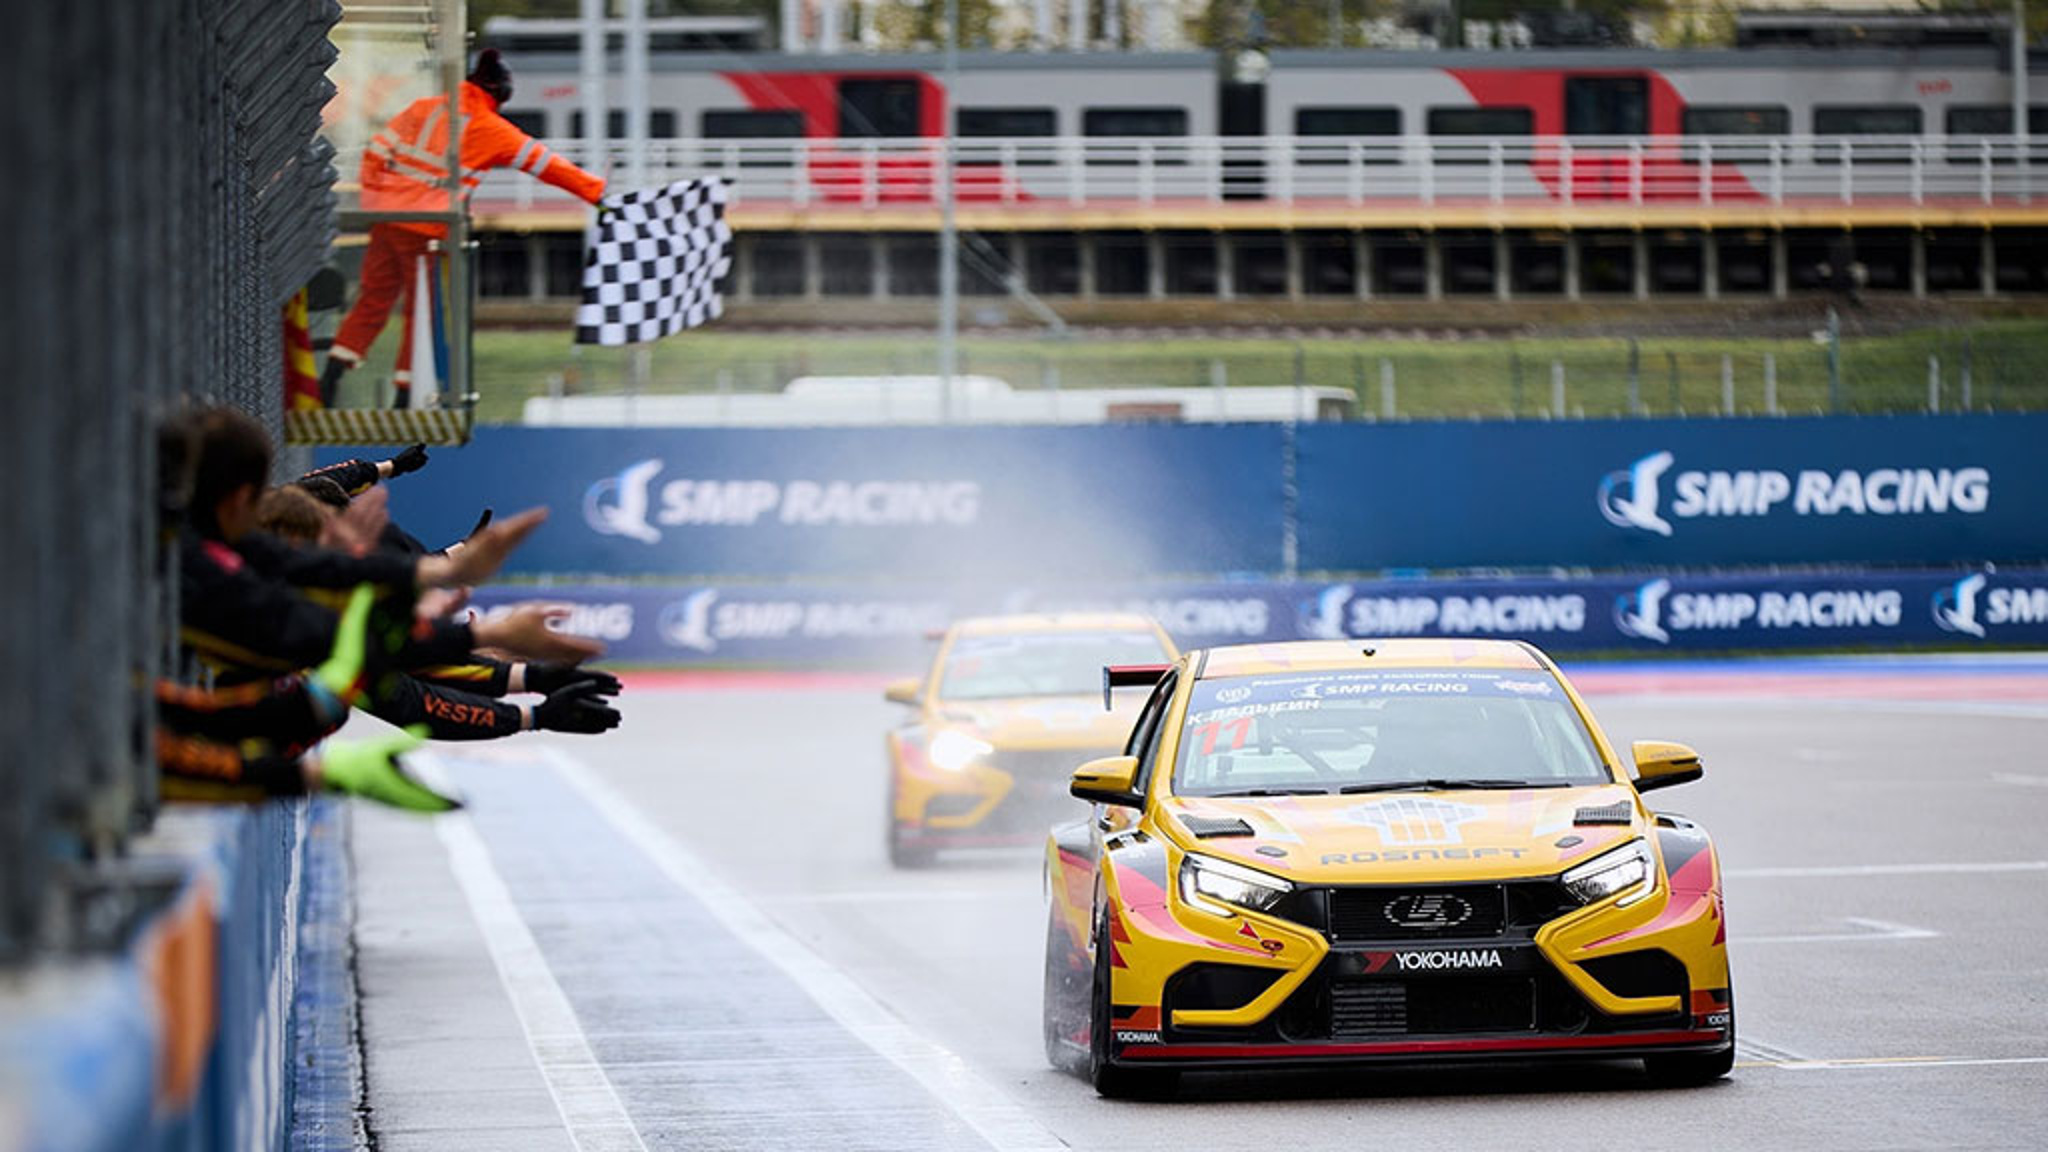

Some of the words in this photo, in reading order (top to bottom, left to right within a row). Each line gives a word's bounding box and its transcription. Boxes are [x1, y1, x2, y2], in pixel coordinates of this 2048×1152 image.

[658, 480, 779, 526] SMP
[779, 480, 980, 526] RACING
[1673, 470, 1790, 517] SMP
[1794, 467, 1990, 514] RACING
[713, 602, 803, 640] SMP
[1350, 596, 1438, 635] SMP
[1438, 594, 1586, 633] RACING
[1669, 593, 1755, 630] SMP
[1757, 589, 1902, 627] RACING
[1985, 587, 2048, 625] SM
[1324, 683, 1376, 695] SMP
[1380, 682, 1470, 693] RACING
[423, 690, 497, 728] VESTA
[1193, 716, 1255, 757] 11
[1320, 847, 1529, 866] ROSNEFT
[1396, 949, 1502, 971] YOKOHAMA
